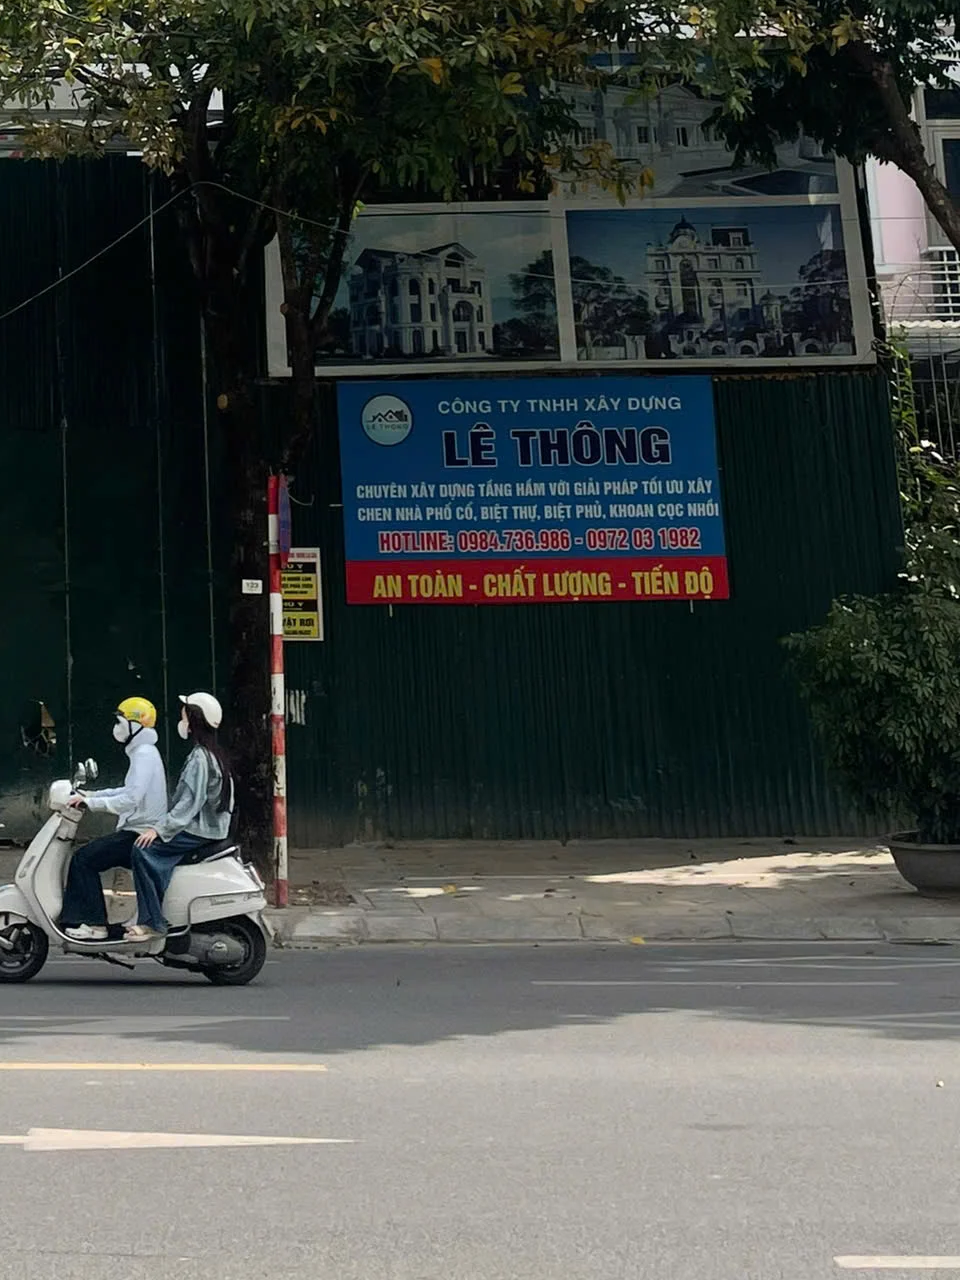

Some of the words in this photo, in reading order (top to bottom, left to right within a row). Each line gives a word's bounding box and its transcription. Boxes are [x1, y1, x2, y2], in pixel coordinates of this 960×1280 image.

[438, 397, 491, 414] CÔNG
[497, 400, 520, 413] TY
[526, 398, 578, 412] TNHH
[584, 395, 621, 411] XÂY
[627, 395, 682, 413] DỰNG
[442, 422, 498, 468] LÊ
[510, 420, 672, 467] THÔNG
[356, 482, 408, 499] CHUYÊN
[410, 481, 436, 499] XÂY
[439, 483, 475, 500] DỰNG
[549, 479, 570, 496] VỚI
[574, 476, 600, 496] GIẢI
[603, 478, 638, 495] PHÁP
[641, 476, 662, 495] TỐI
[666, 480, 684, 494] ƯU
[687, 477, 713, 494] XÂY
[357, 508, 392, 521] CHEN
[395, 503, 422, 521] NHÀ
[426, 502, 452, 520] PHỐ
[481, 504, 509, 523] BIỆT
[512, 503, 541, 522] THỰ,
[544, 502, 572, 521] BIỆT
[575, 500, 607, 519] PHỦ,
[610, 503, 654, 519] KHOAN
[657, 503, 683, 520] CỌC
[378, 531, 455, 553] HOTLINE:
[456, 529, 572, 552] 0984.736.986
[586, 528, 630, 550] 0972
[631, 527, 655, 550] 03
[657, 527, 702, 550] 1982
[372, 575, 403, 598] AN
[407, 569, 464, 598] TOÀN
[483, 564, 537, 597] CHẤT
[542, 570, 612, 600] LƯỢNG
[631, 563, 679, 595] TIẾN
[684, 566, 714, 599] ĐỘ
